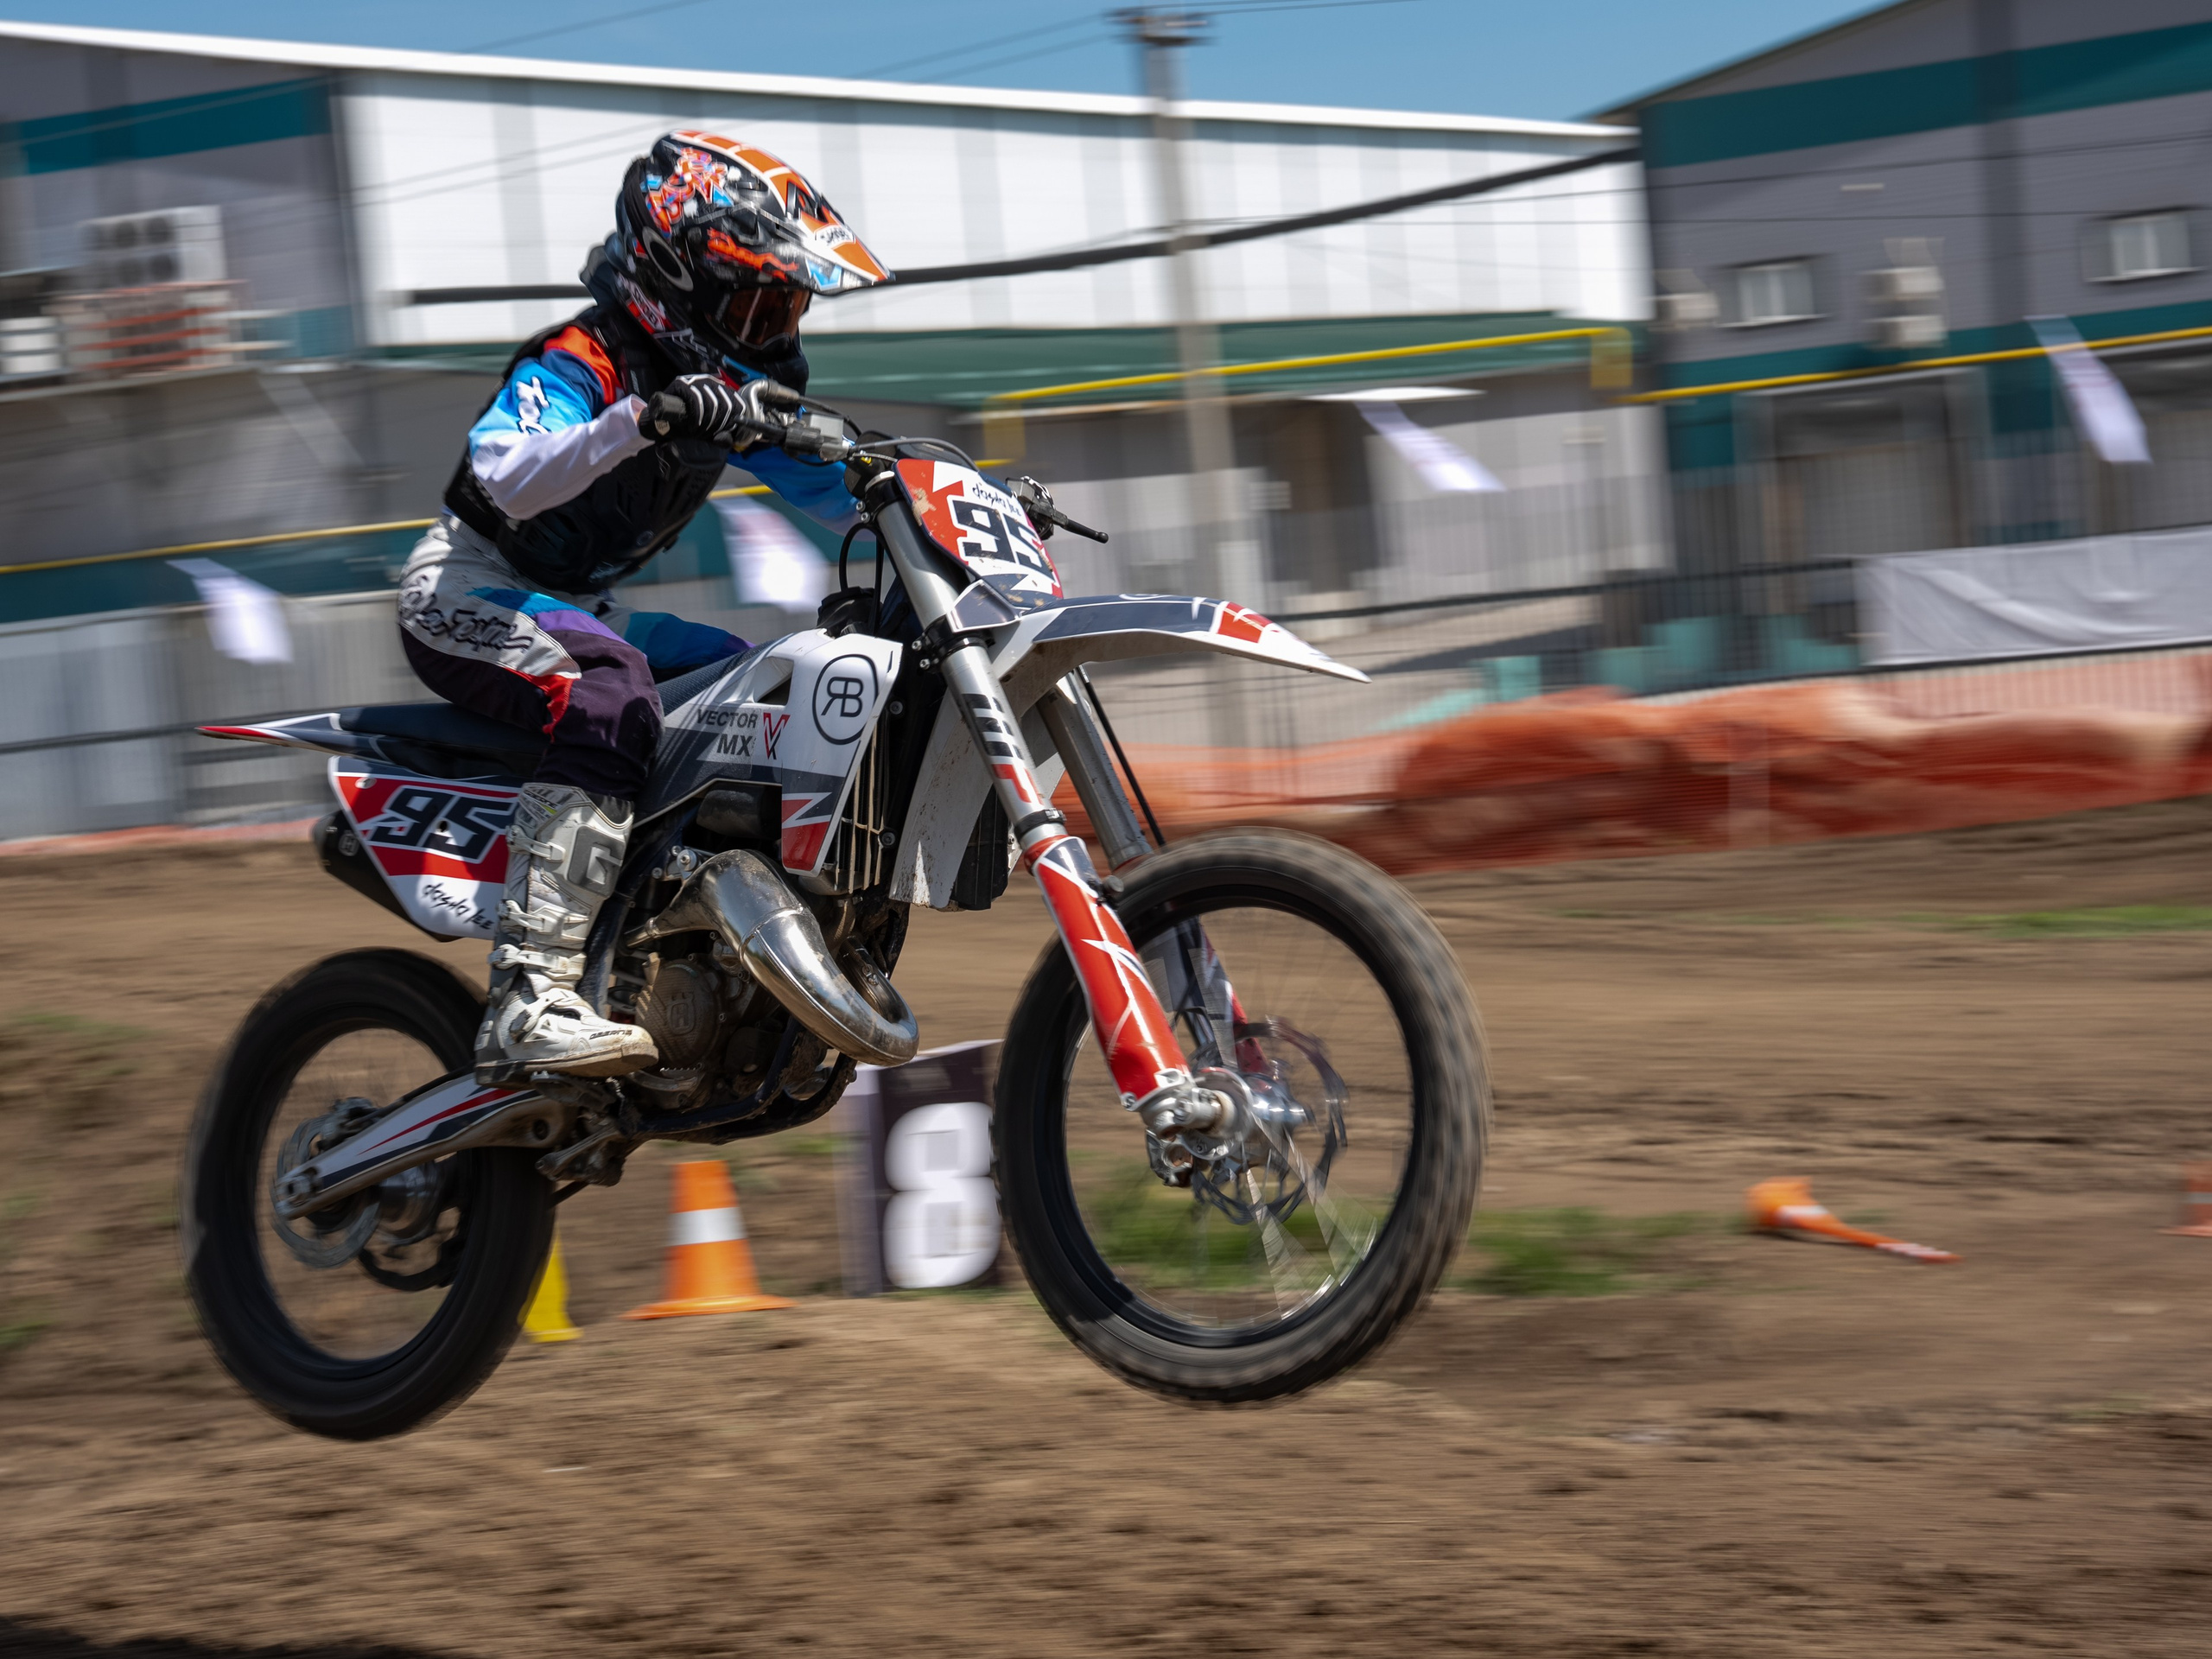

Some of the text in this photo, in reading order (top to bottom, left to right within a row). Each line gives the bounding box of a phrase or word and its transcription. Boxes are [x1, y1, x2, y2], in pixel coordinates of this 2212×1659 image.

[952, 499, 1056, 583] 95
[696, 709, 759, 729] VECTOR
[716, 734, 753, 757] MX
[369, 787, 518, 862] 95
[883, 1102, 1002, 1289] 8
